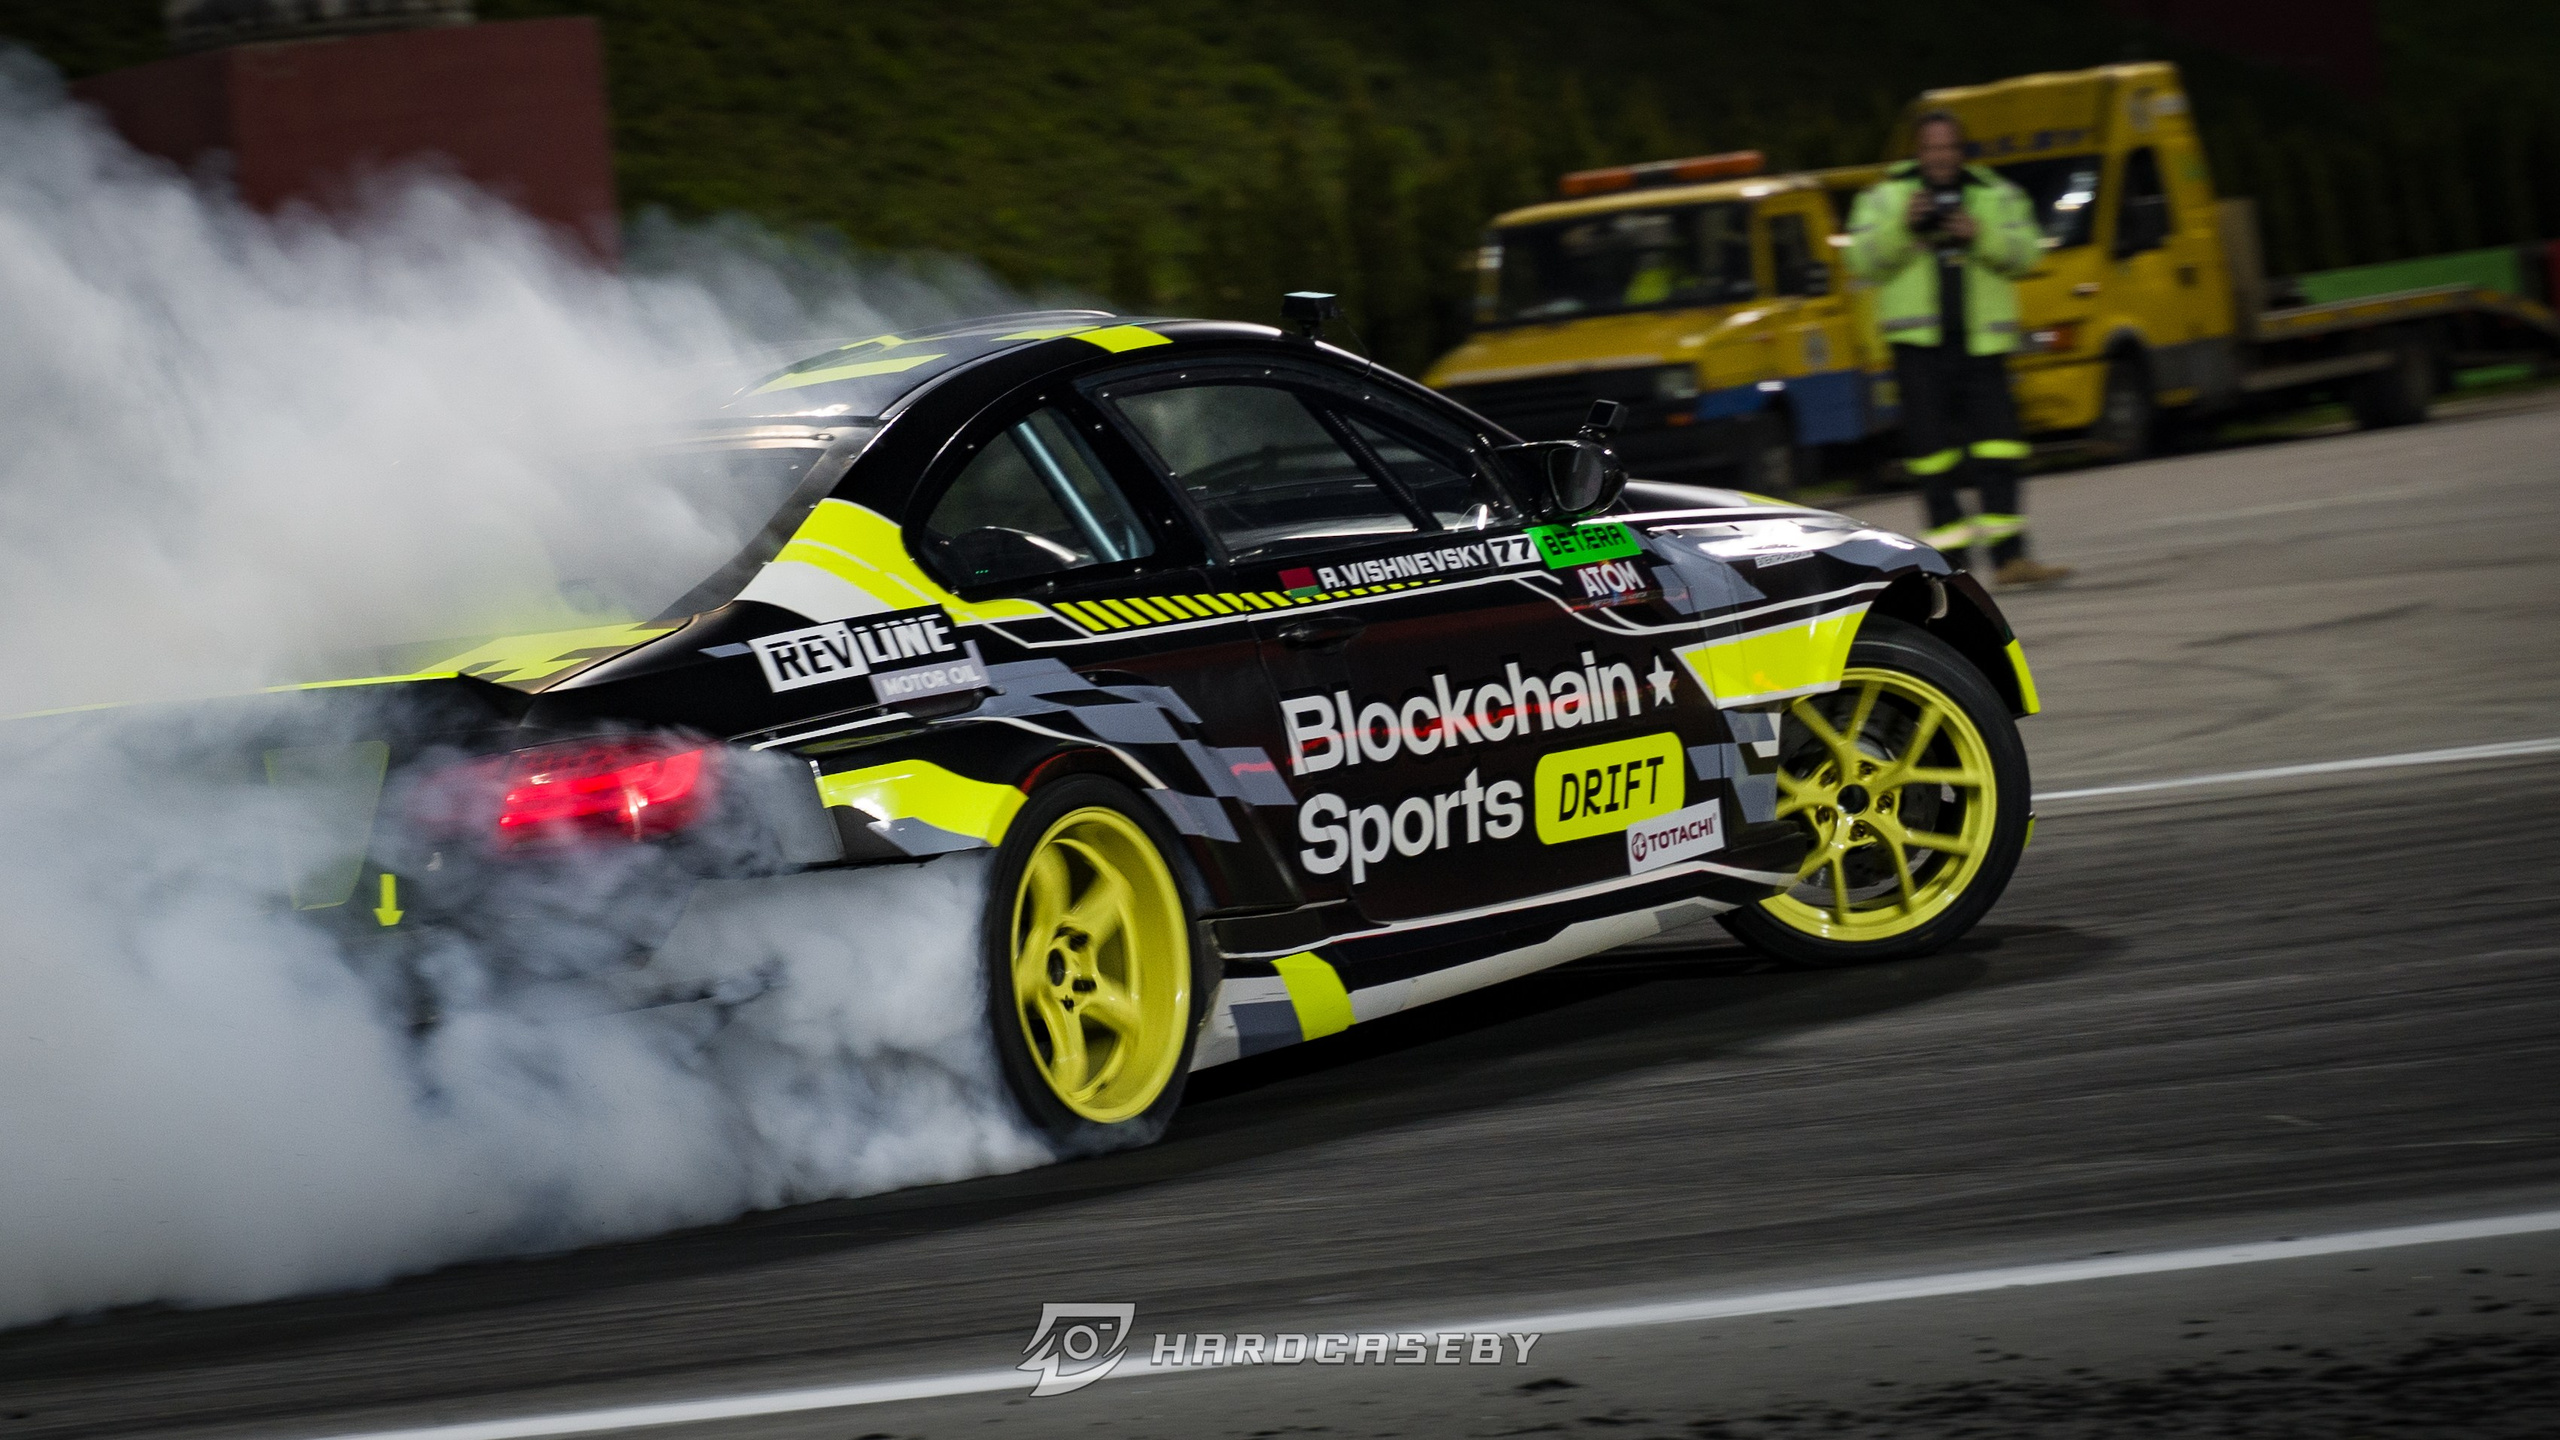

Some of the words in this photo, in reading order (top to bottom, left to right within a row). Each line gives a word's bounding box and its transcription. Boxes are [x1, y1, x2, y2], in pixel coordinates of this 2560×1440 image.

[1317, 543, 1491, 589] A.VISHNEVSKY
[1490, 537, 1533, 563] 77
[1542, 525, 1627, 556] BETERA
[1577, 560, 1646, 598] ATOM
[881, 669, 949, 696] MOTOR
[949, 664, 981, 684] OIL
[1281, 651, 1642, 776] Blockchain
[1300, 767, 1524, 885] Sports
[1558, 755, 1665, 822] DRIFT
